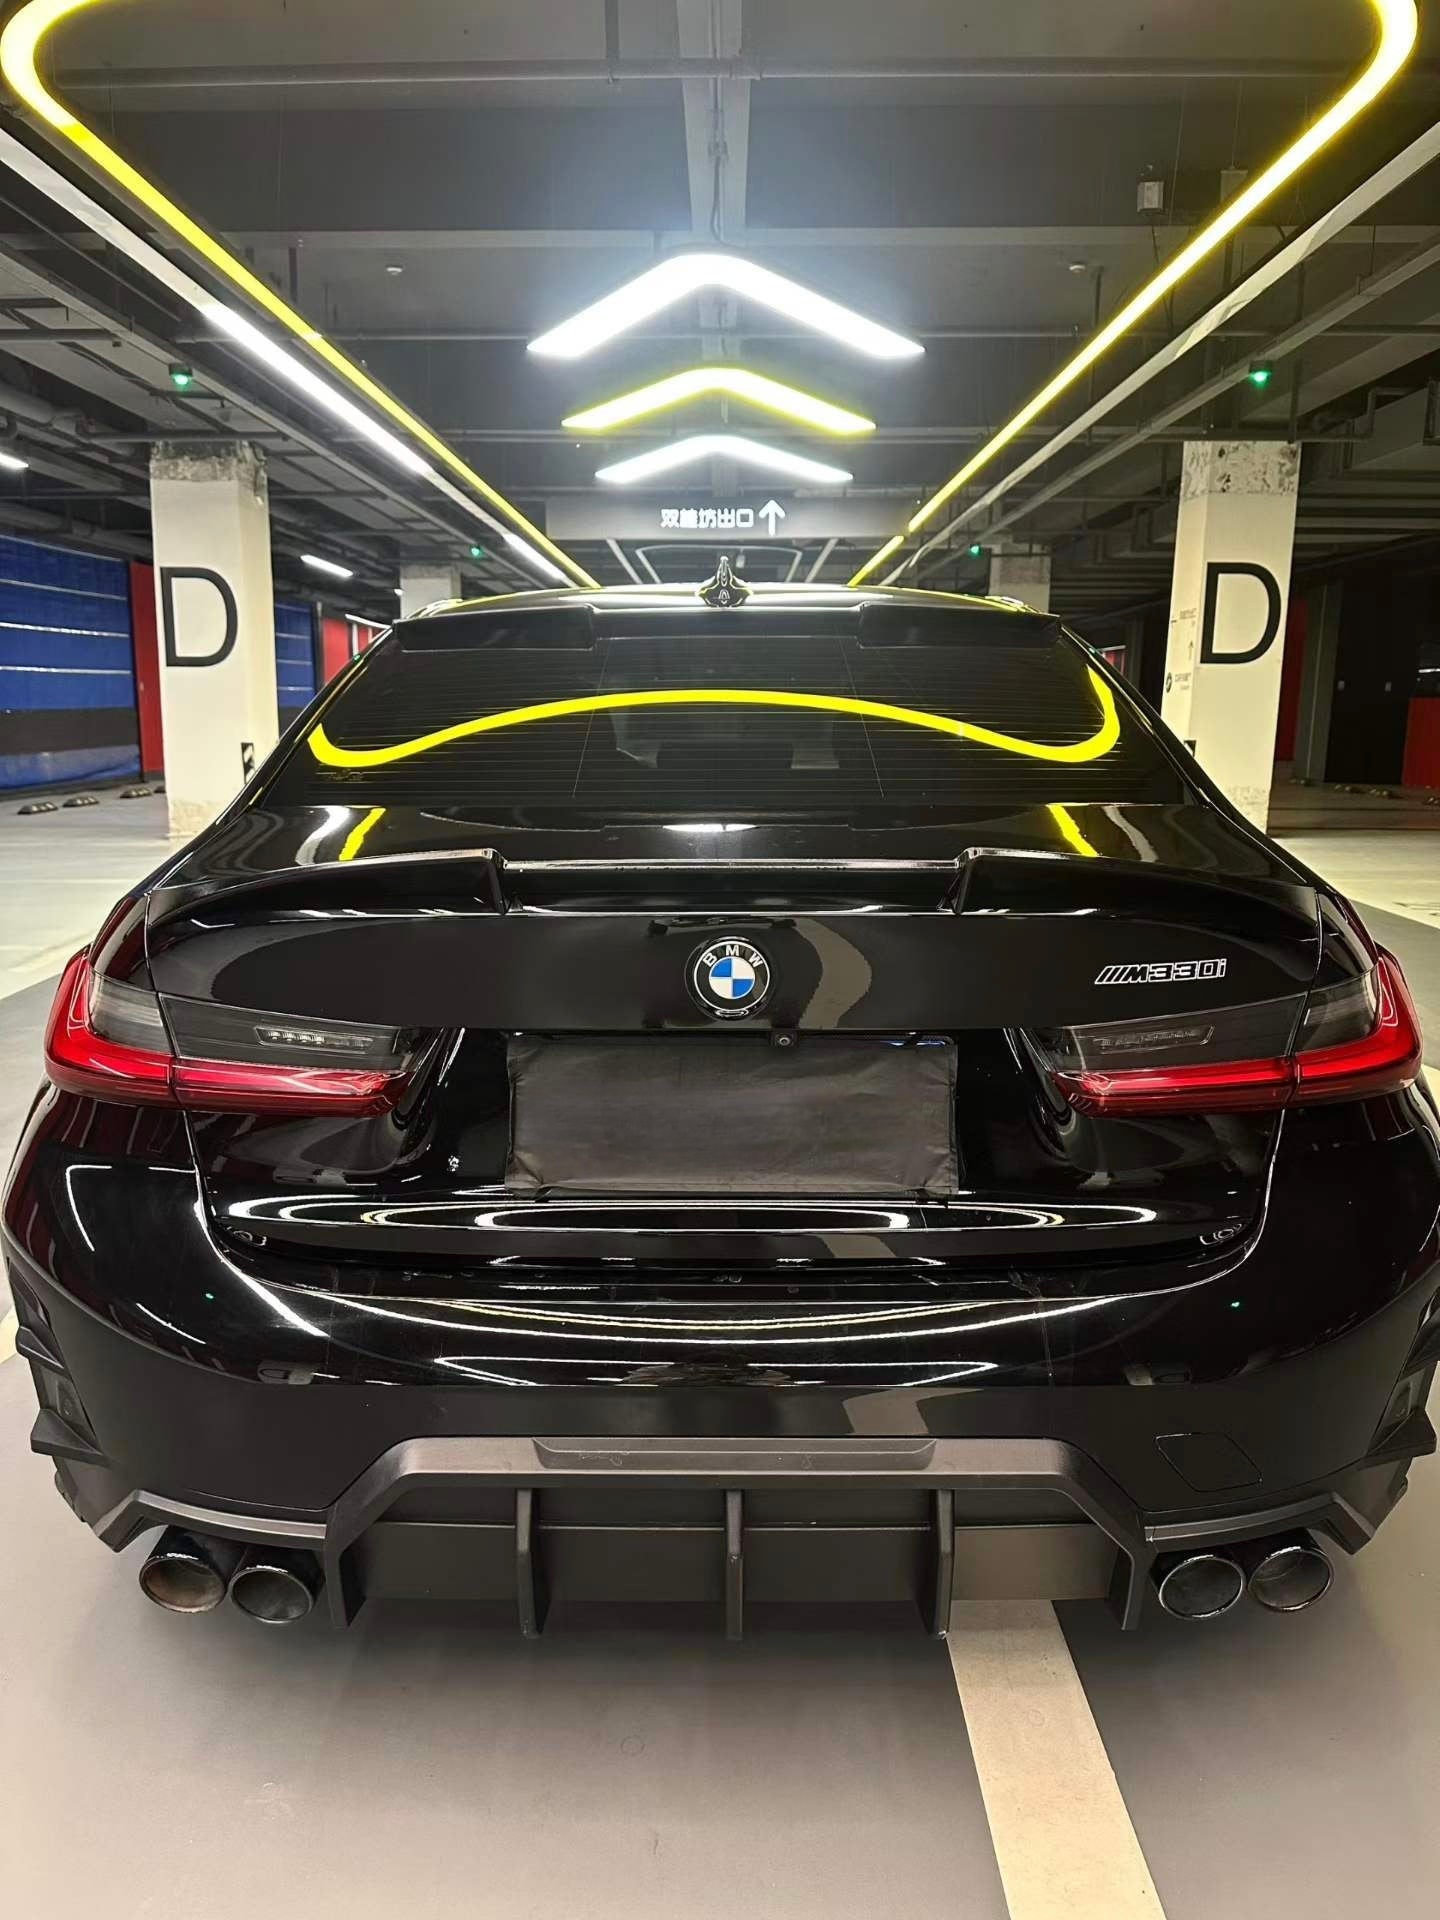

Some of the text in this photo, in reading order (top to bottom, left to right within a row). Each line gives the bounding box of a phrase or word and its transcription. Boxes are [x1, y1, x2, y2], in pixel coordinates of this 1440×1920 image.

[160, 567, 238, 667] D
[1200, 562, 1281, 664] D
[703, 944, 763, 967] BMW
